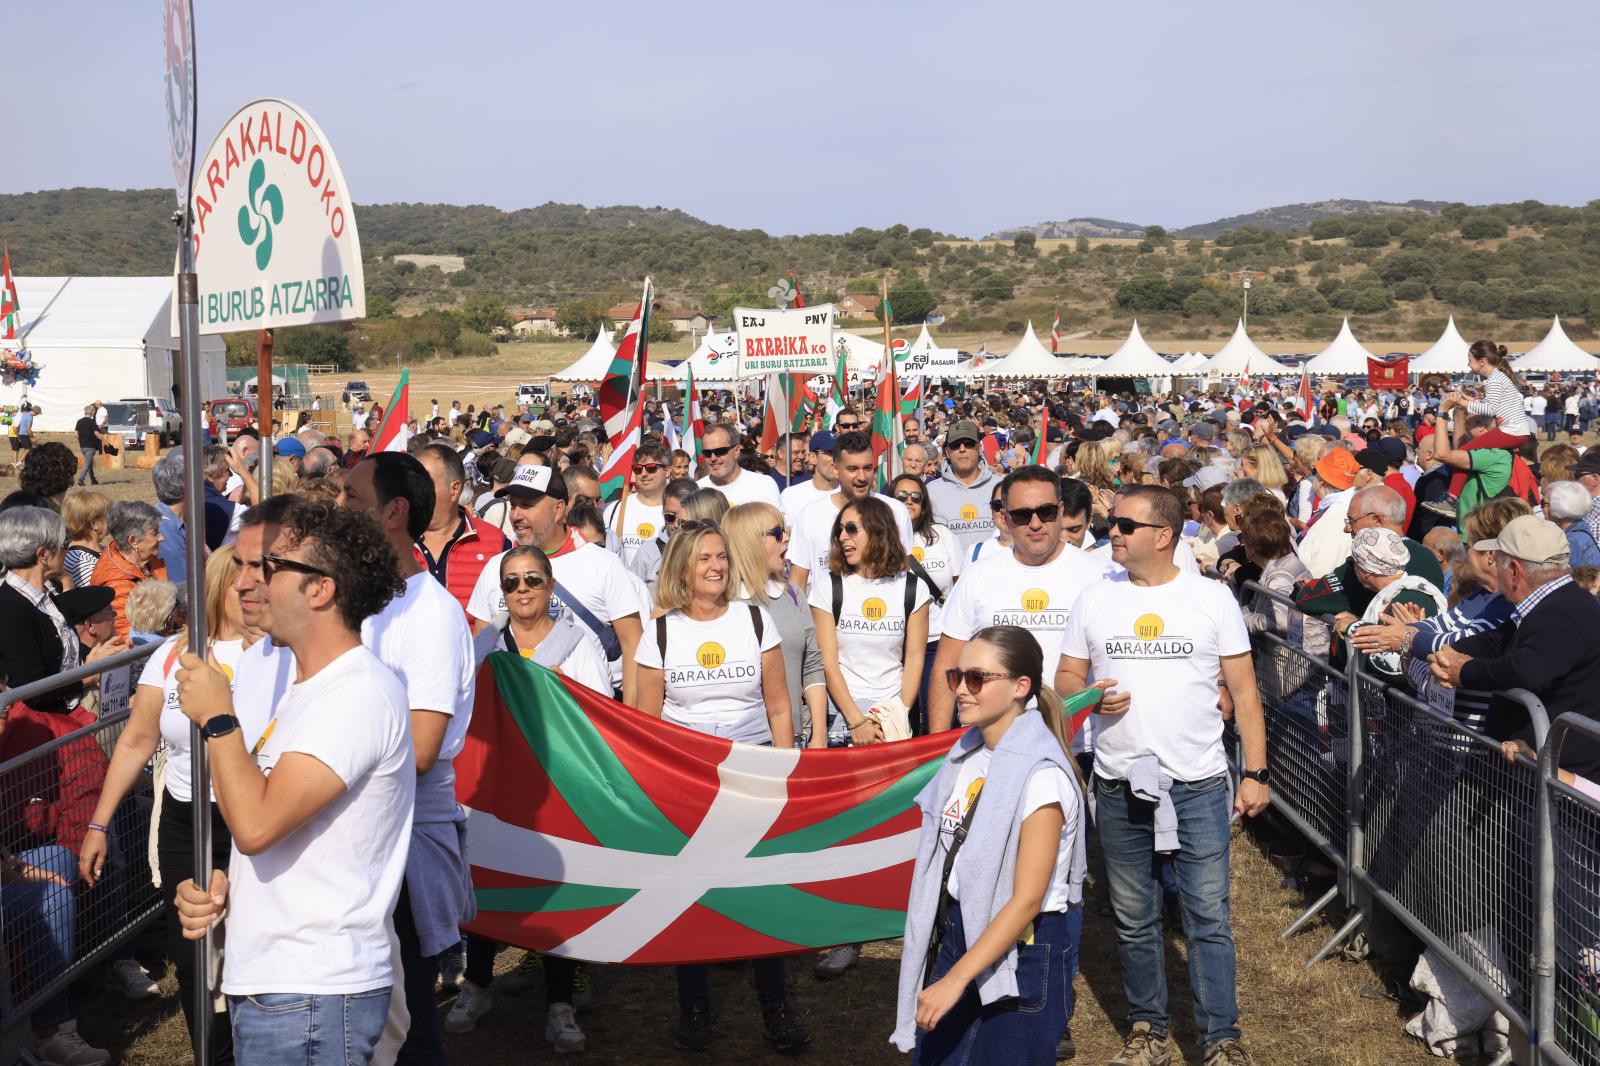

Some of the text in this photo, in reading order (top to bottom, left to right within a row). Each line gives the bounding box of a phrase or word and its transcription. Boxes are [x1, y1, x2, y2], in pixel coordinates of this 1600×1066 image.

[742, 312, 828, 328] EAJ PNV
[760, 360, 782, 369] BURU
[783, 358, 828, 368] BATZARRA
[913, 352, 929, 365] eaj
[904, 362, 925, 372] pnv
[526, 468, 539, 477] AM
[947, 520, 995, 531] ARAKALDO
[1026, 599, 1044, 610] gora
[866, 607, 882, 618] gora
[1139, 625, 1158, 637] gora
[1105, 641, 1194, 655] BARAKALDO
[702, 653, 720, 666] gora
[670, 665, 756, 683] BARAKALDO
